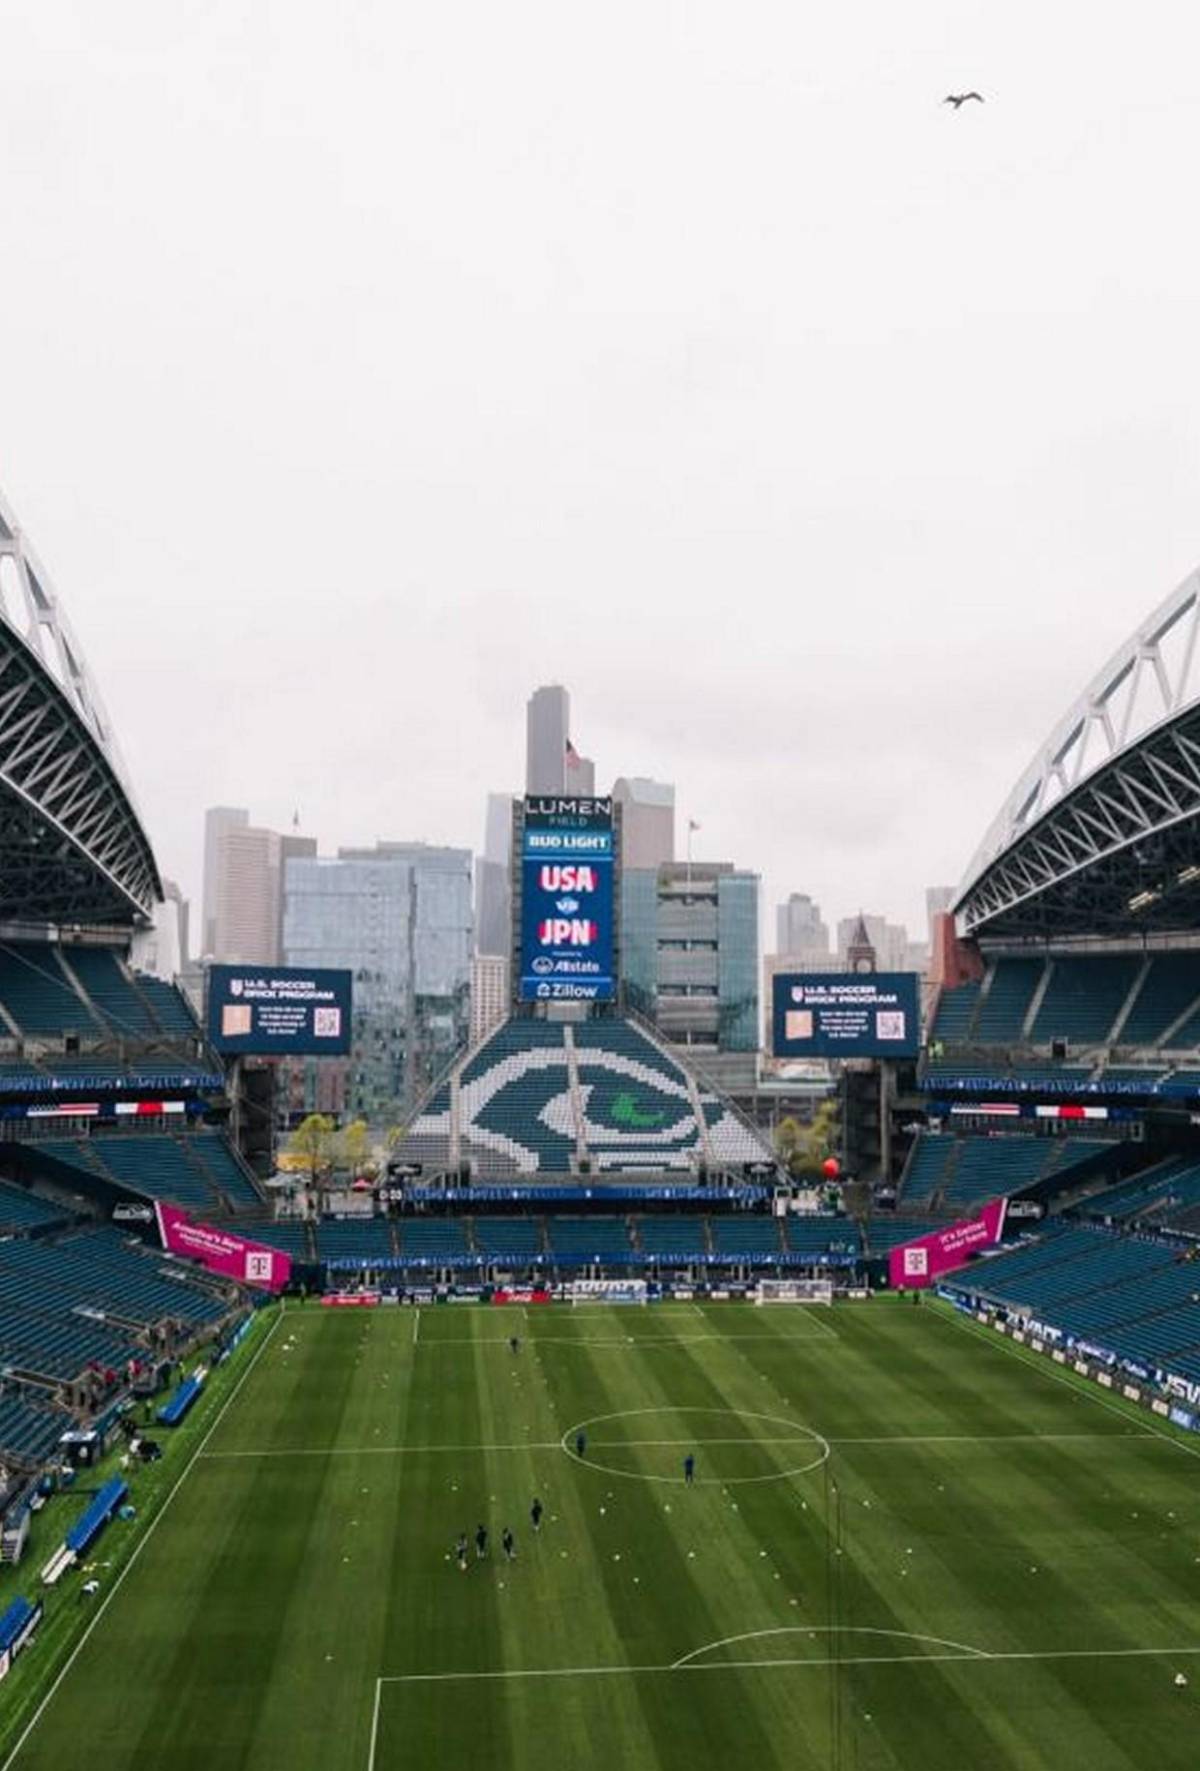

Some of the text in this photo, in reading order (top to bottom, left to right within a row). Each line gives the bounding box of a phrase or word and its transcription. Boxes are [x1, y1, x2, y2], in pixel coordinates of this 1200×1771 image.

[526, 800, 611, 814] LUMEN
[549, 816, 588, 827] FIELD
[529, 835, 607, 848] BUD LIGHT
[541, 865, 595, 892] USA
[541, 918, 592, 946] JPN
[553, 960, 600, 973] Allstate
[270, 981, 315, 989] SOCCER
[552, 983, 599, 998] Zillow
[830, 985, 876, 994] SOCCER
